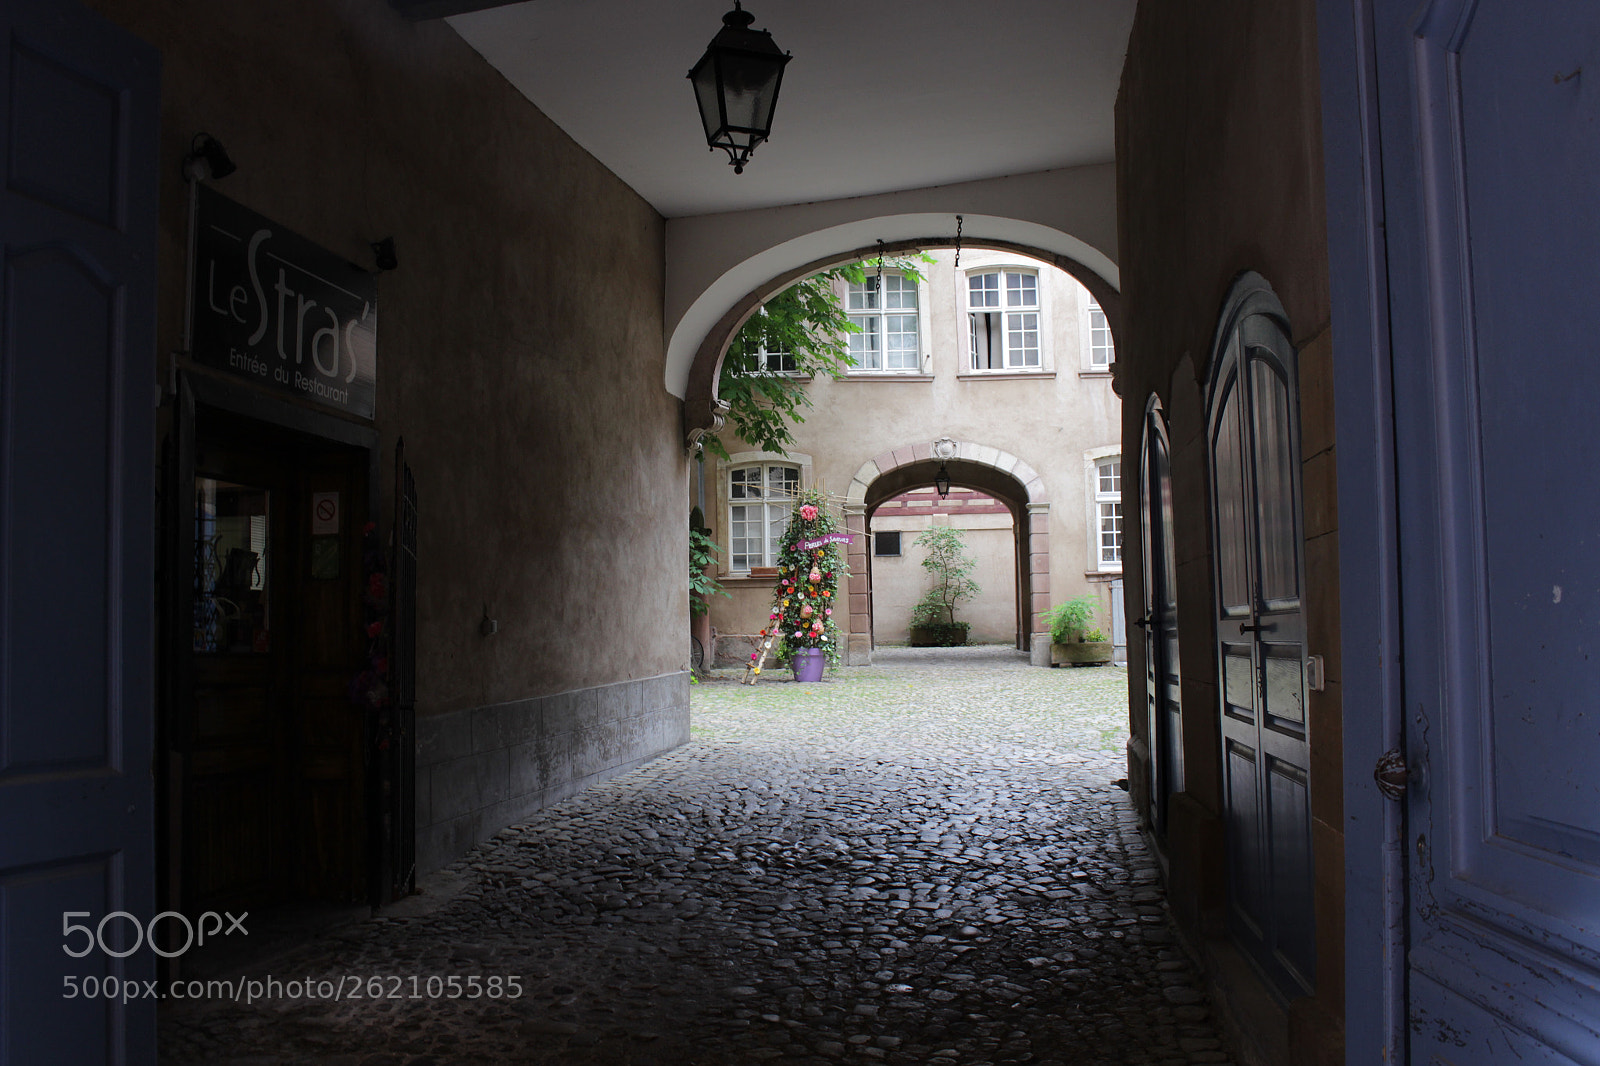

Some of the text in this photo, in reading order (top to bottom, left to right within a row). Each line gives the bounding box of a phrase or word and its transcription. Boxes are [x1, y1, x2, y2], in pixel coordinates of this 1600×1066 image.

[229, 347, 350, 405] Entrée du Restaurant
